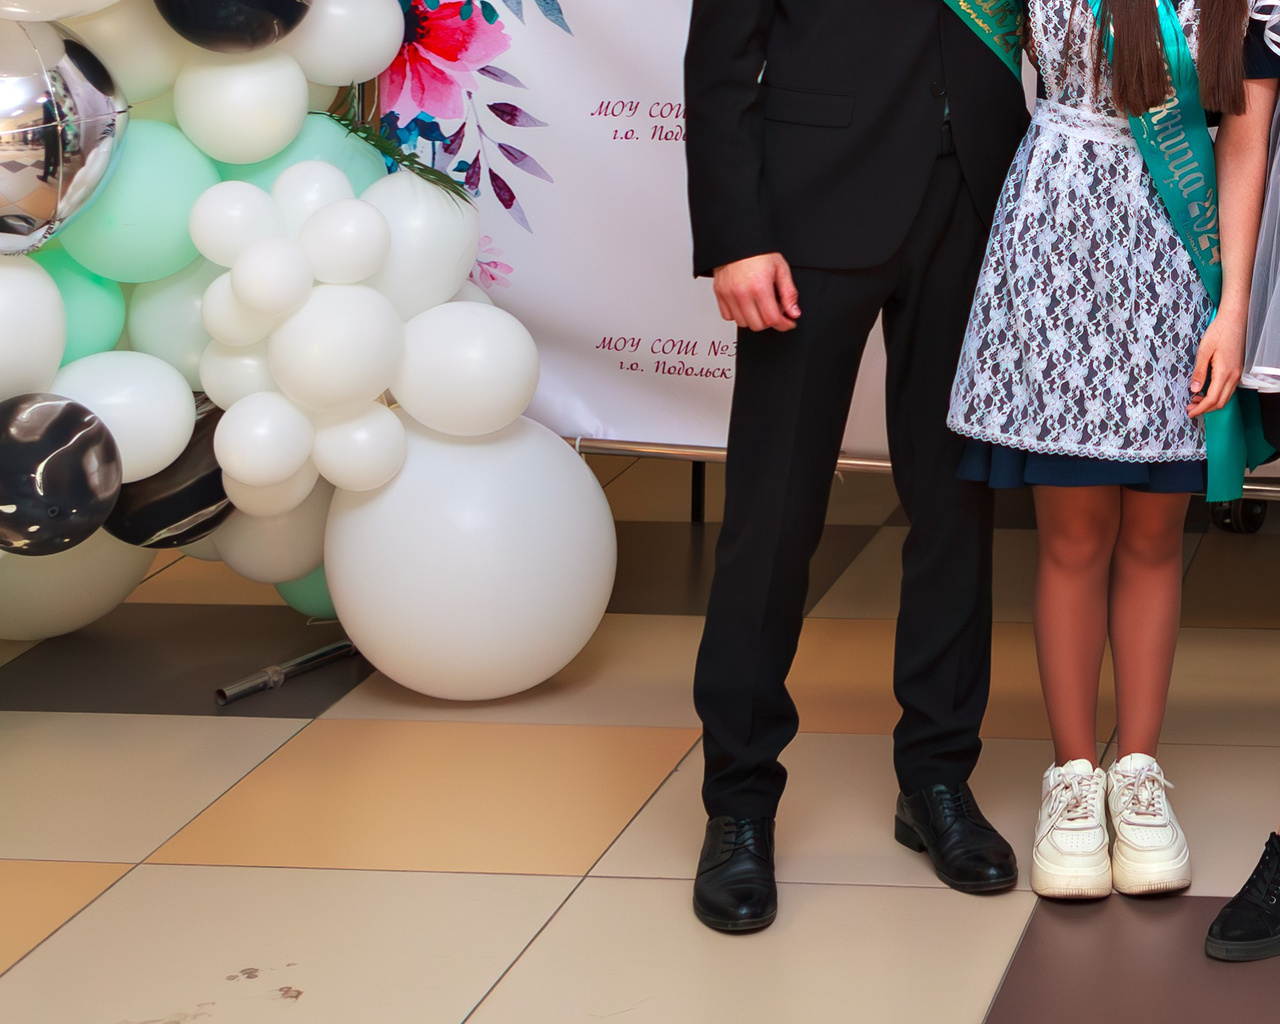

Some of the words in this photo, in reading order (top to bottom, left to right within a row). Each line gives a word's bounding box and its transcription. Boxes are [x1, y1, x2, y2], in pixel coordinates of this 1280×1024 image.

[590, 100, 641, 118] МОУ
[612, 128, 640, 141] г.о.
[595, 336, 642, 353] МОУ
[650, 338, 699, 357] СОШ
[707, 339, 738, 357] №3
[619, 360, 644, 373] г.о.
[654, 360, 733, 380] Подольск
